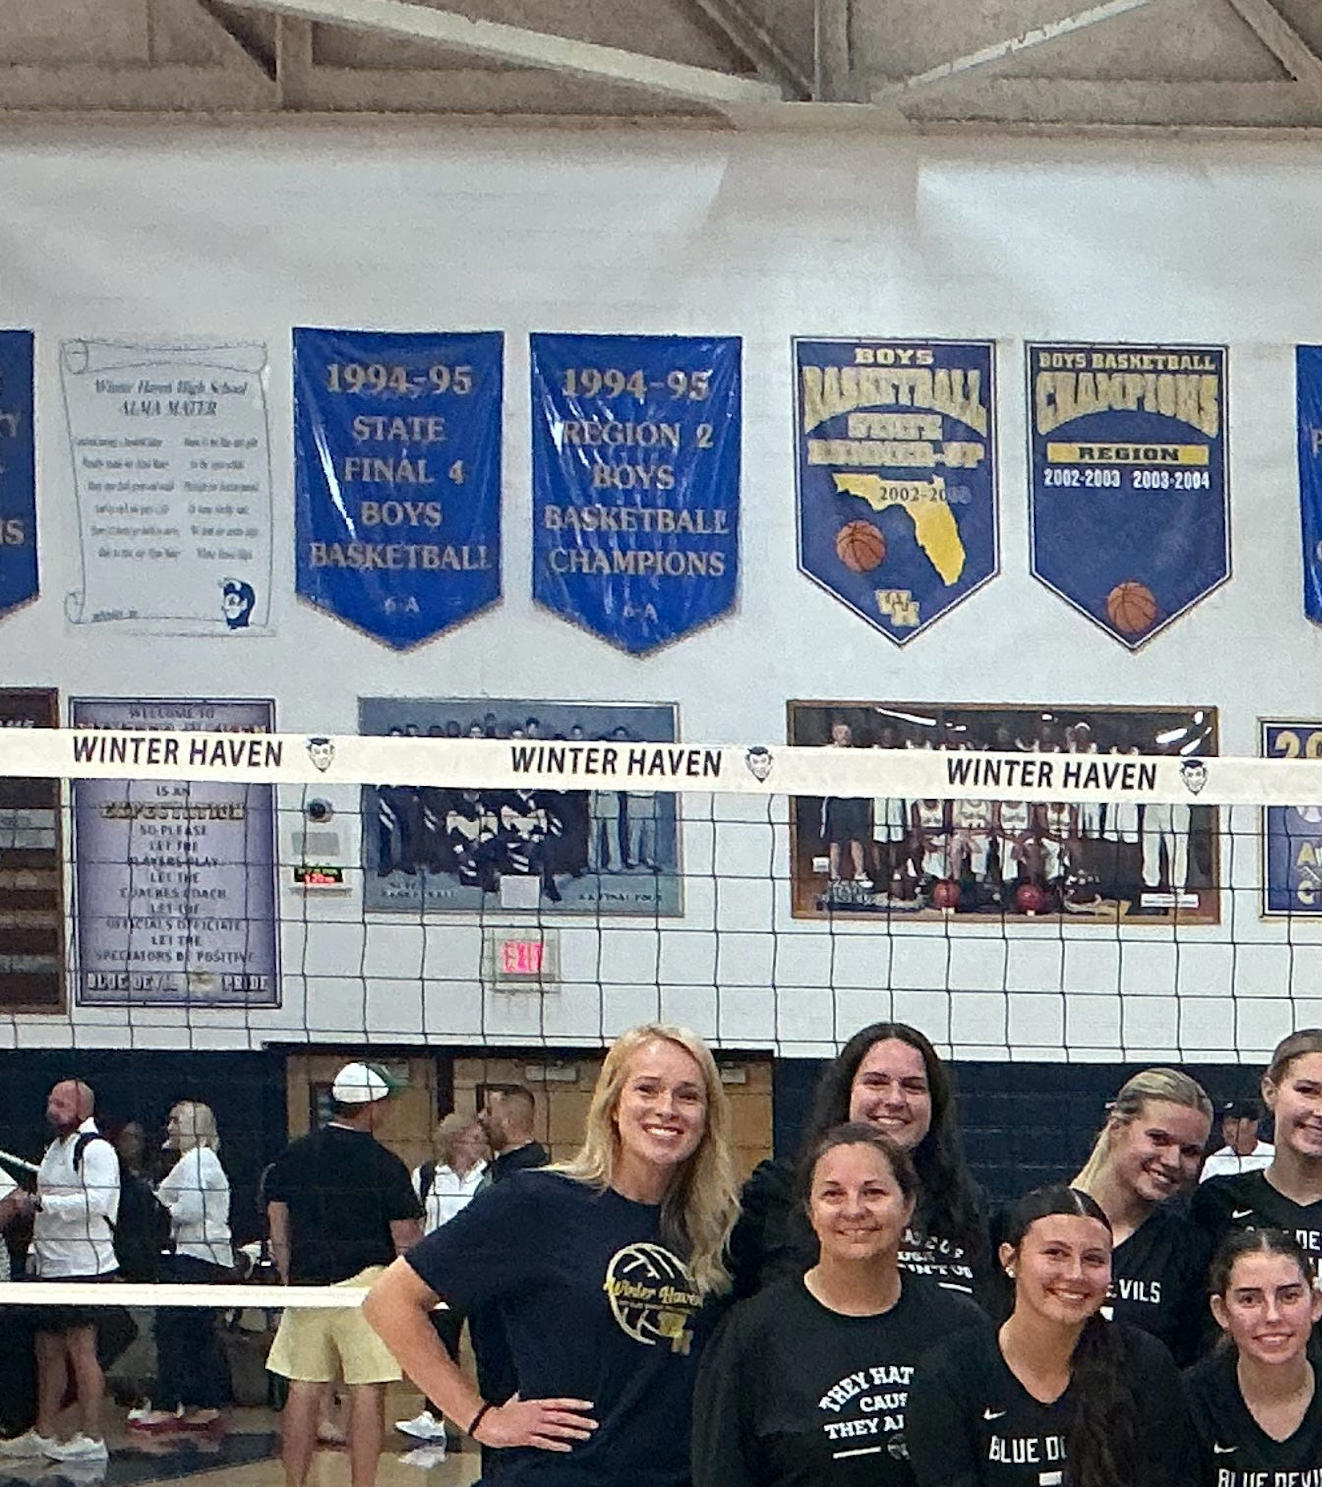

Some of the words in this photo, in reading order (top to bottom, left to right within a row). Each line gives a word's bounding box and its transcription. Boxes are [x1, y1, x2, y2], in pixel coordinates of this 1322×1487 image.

[855, 348, 934, 365] BOYS
[1039, 353, 1086, 368] BOYS
[1092, 353, 1216, 371] BASKETBALL
[327, 364, 472, 395] 1994-95
[563, 369, 711, 400] 1994-95
[1036, 371, 1219, 440] CHAMPIONS
[353, 416, 446, 441] STATE
[562, 423, 680, 447] REGION
[696, 424, 714, 448] 2
[1078, 447, 1180, 462] REGION
[344, 459, 434, 483] FINAL
[449, 459, 466, 485] 4
[593, 465, 675, 490] BOYS
[361, 502, 442, 527] BOYS
[544, 505, 729, 534] BASKETBALL
[310, 543, 493, 570] BASKETBALL
[549, 550, 725, 577] CHAMPIONS
[73, 736, 180, 765] WINTER
[189, 739, 283, 768] HAVEN
[511, 746, 617, 775] WINTER
[627, 748, 722, 777] HAVEN
[947, 757, 1053, 789] WINTER
[1062, 759, 1157, 791] HAVEN
[818, 1371, 870, 1413] THEY
[824, 1417, 878, 1440] THEY
[989, 1434, 1040, 1463] BLUE
